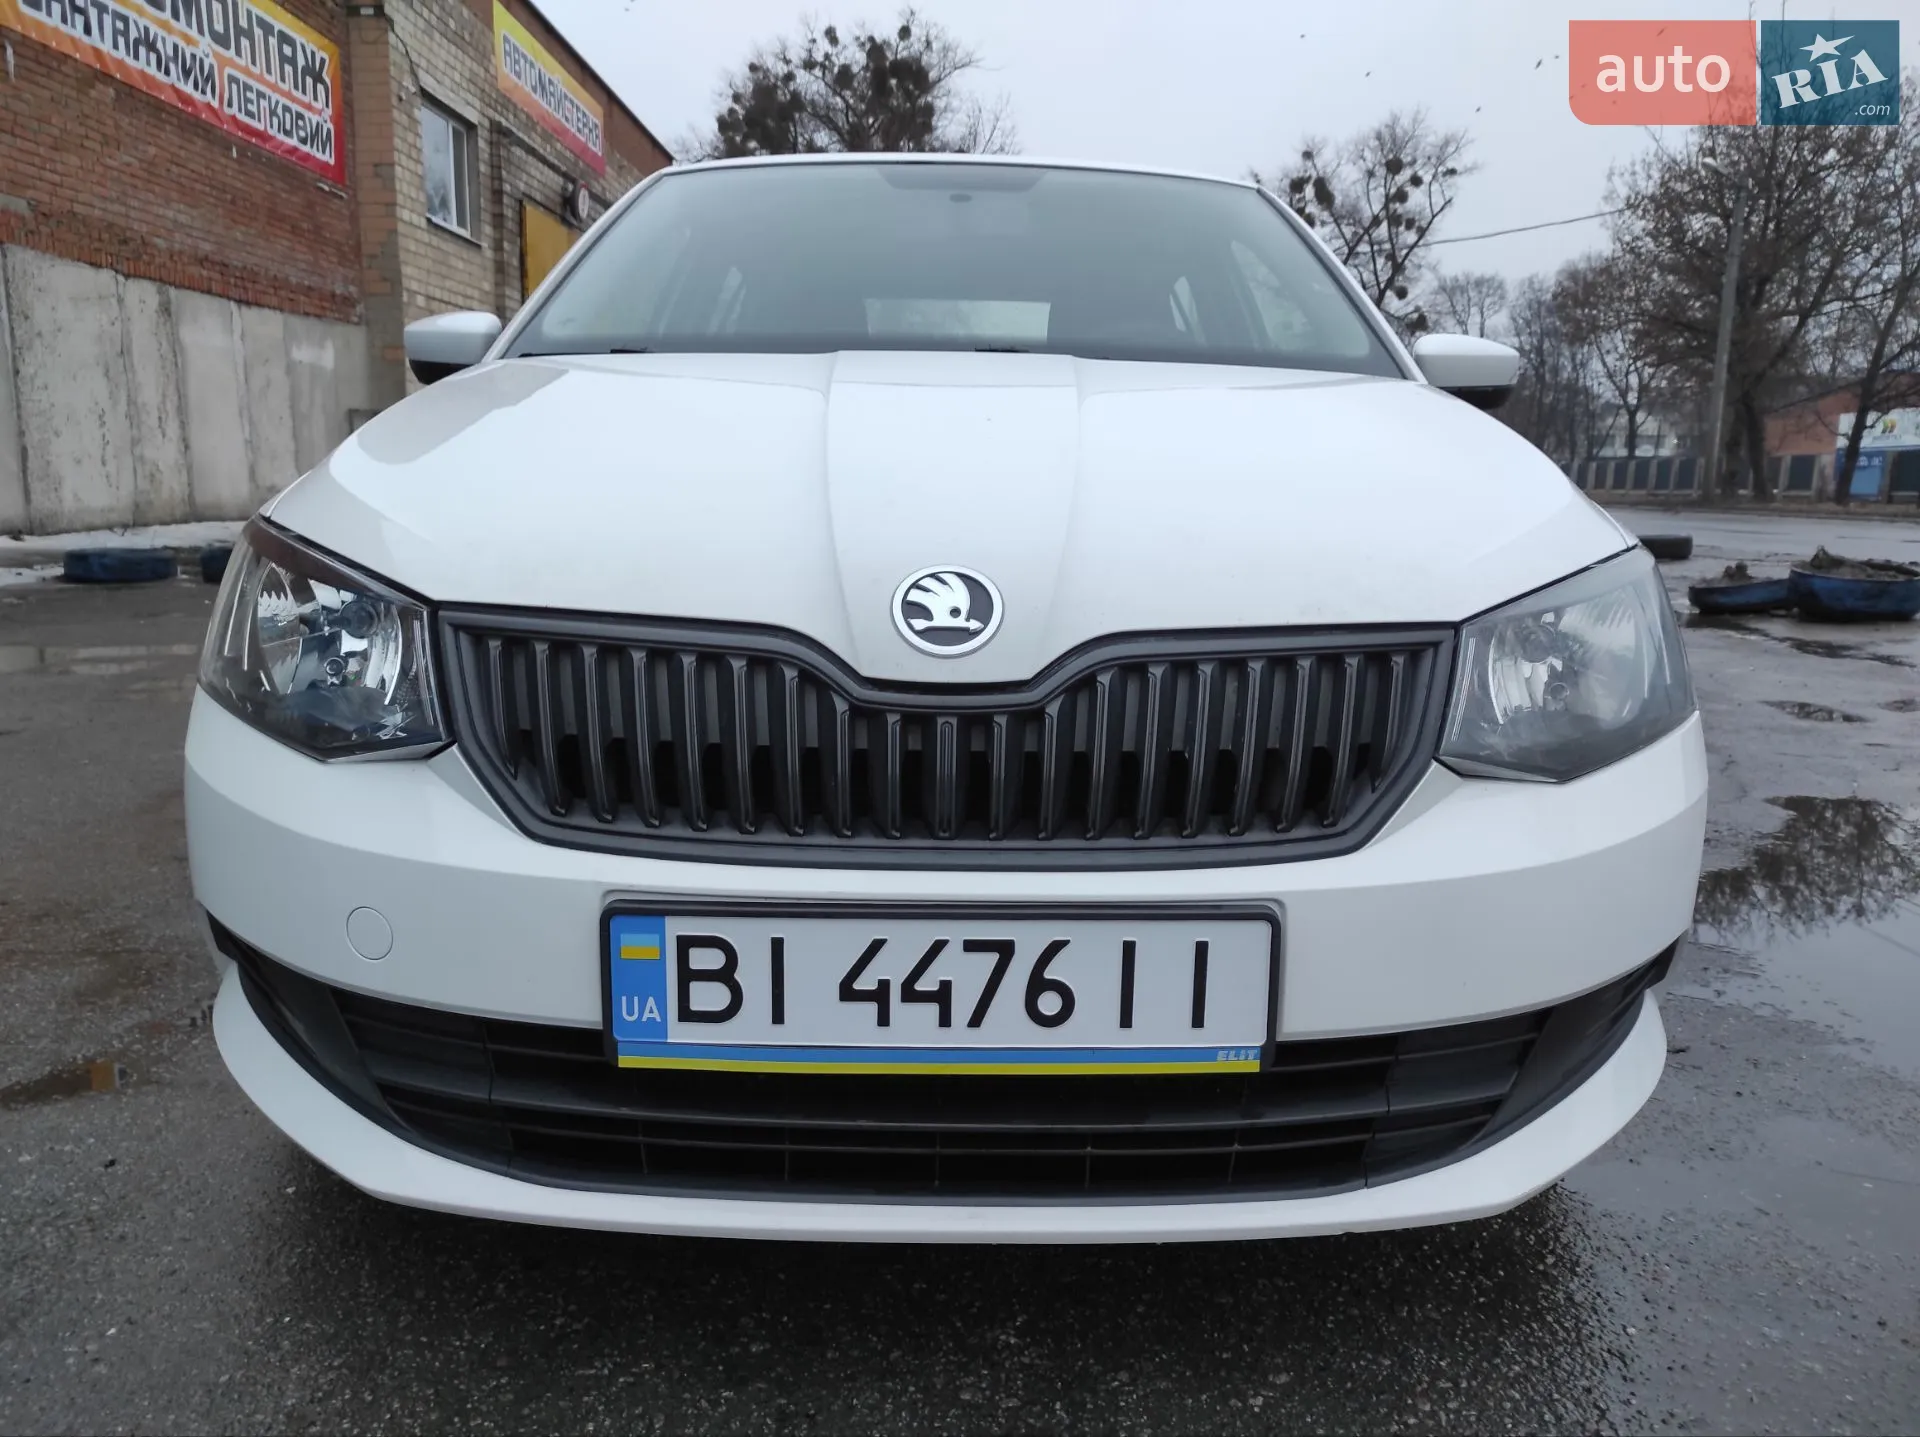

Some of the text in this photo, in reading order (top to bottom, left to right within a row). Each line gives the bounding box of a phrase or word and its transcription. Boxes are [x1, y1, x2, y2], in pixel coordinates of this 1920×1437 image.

[21, 0, 333, 161] АНТАЖНИЙ ЛЕГКОВИЙ
[142, 0, 330, 110] МОНТАЖ
[502, 32, 601, 153] АВТОМАЙСТЕРНЯ
[621, 996, 662, 1022] UA
[676, 934, 785, 1025] BI
[838, 938, 1076, 1028] 4476
[1216, 1048, 1258, 1061] ELIT
